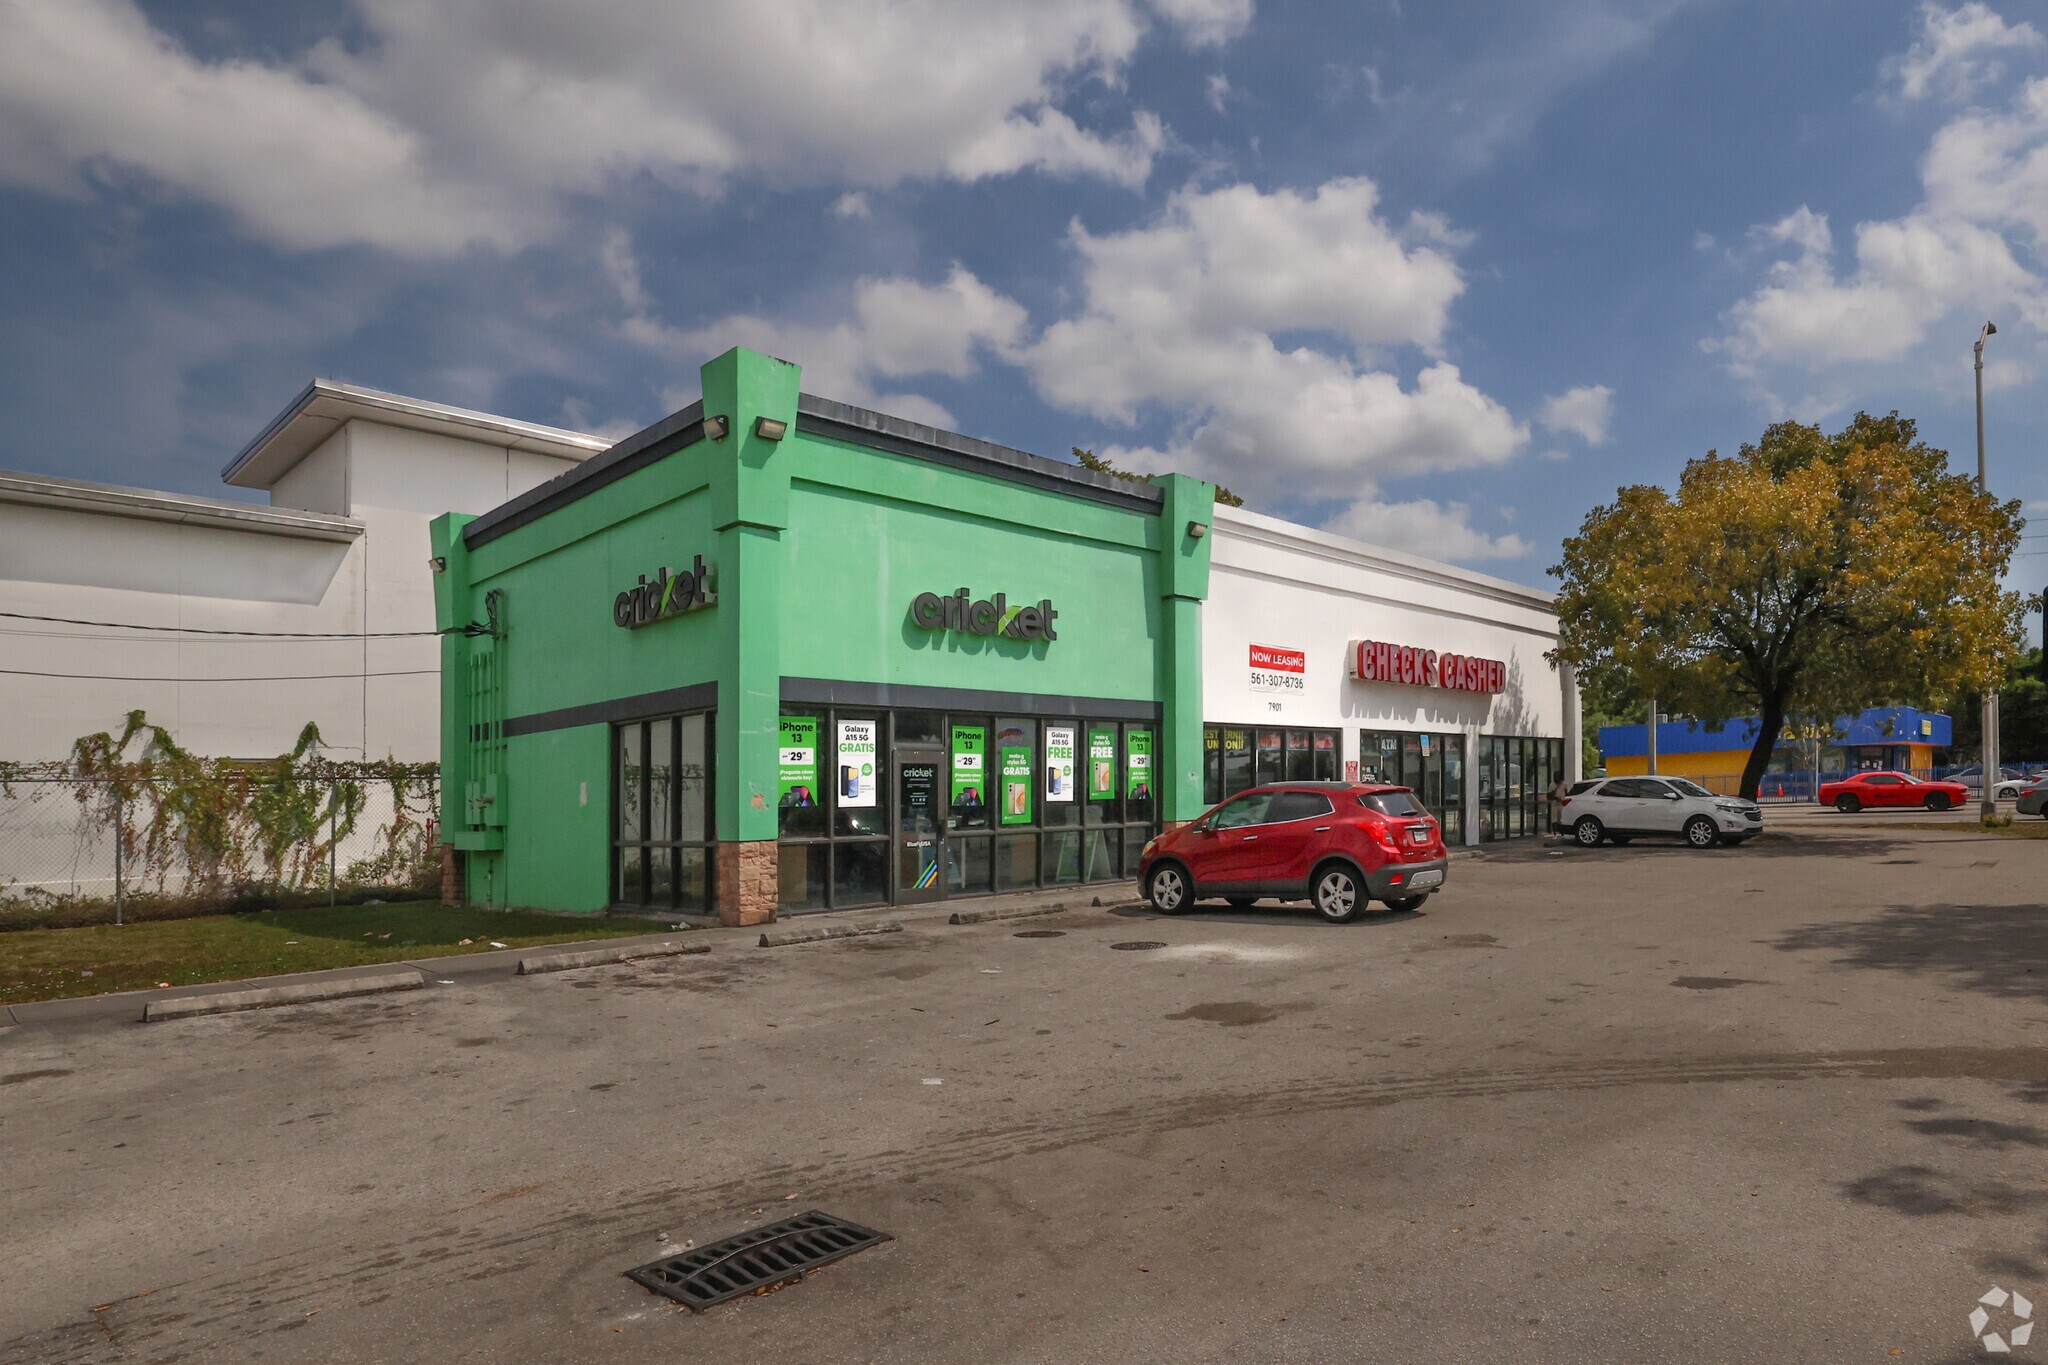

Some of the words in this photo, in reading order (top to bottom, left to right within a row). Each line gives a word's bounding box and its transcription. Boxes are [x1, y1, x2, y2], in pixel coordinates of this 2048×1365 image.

[613, 554, 711, 627] cricket
[913, 587, 1058, 641] cricket
[1251, 651, 1271, 663] NOW
[1273, 654, 1304, 667] LEASING
[1359, 640, 1438, 686] CHECKS
[1442, 653, 1505, 694] CASHED
[779, 722, 814, 732] iPhone
[844, 725, 869, 734] Galaxy
[791, 734, 803, 743] 13
[955, 731, 982, 740] iPhone
[1051, 731, 1069, 739] Galaxy
[1129, 735, 1150, 743] iPhone
[839, 743, 875, 753] GRATIS
[964, 741, 973, 750] 13
[1381, 738, 1397, 750] ATM
[1047, 746, 1073, 759] FREE
[1090, 746, 1113, 758] FREE
[903, 768, 933, 778] cricket
[1003, 766, 1030, 776] GRATIS
